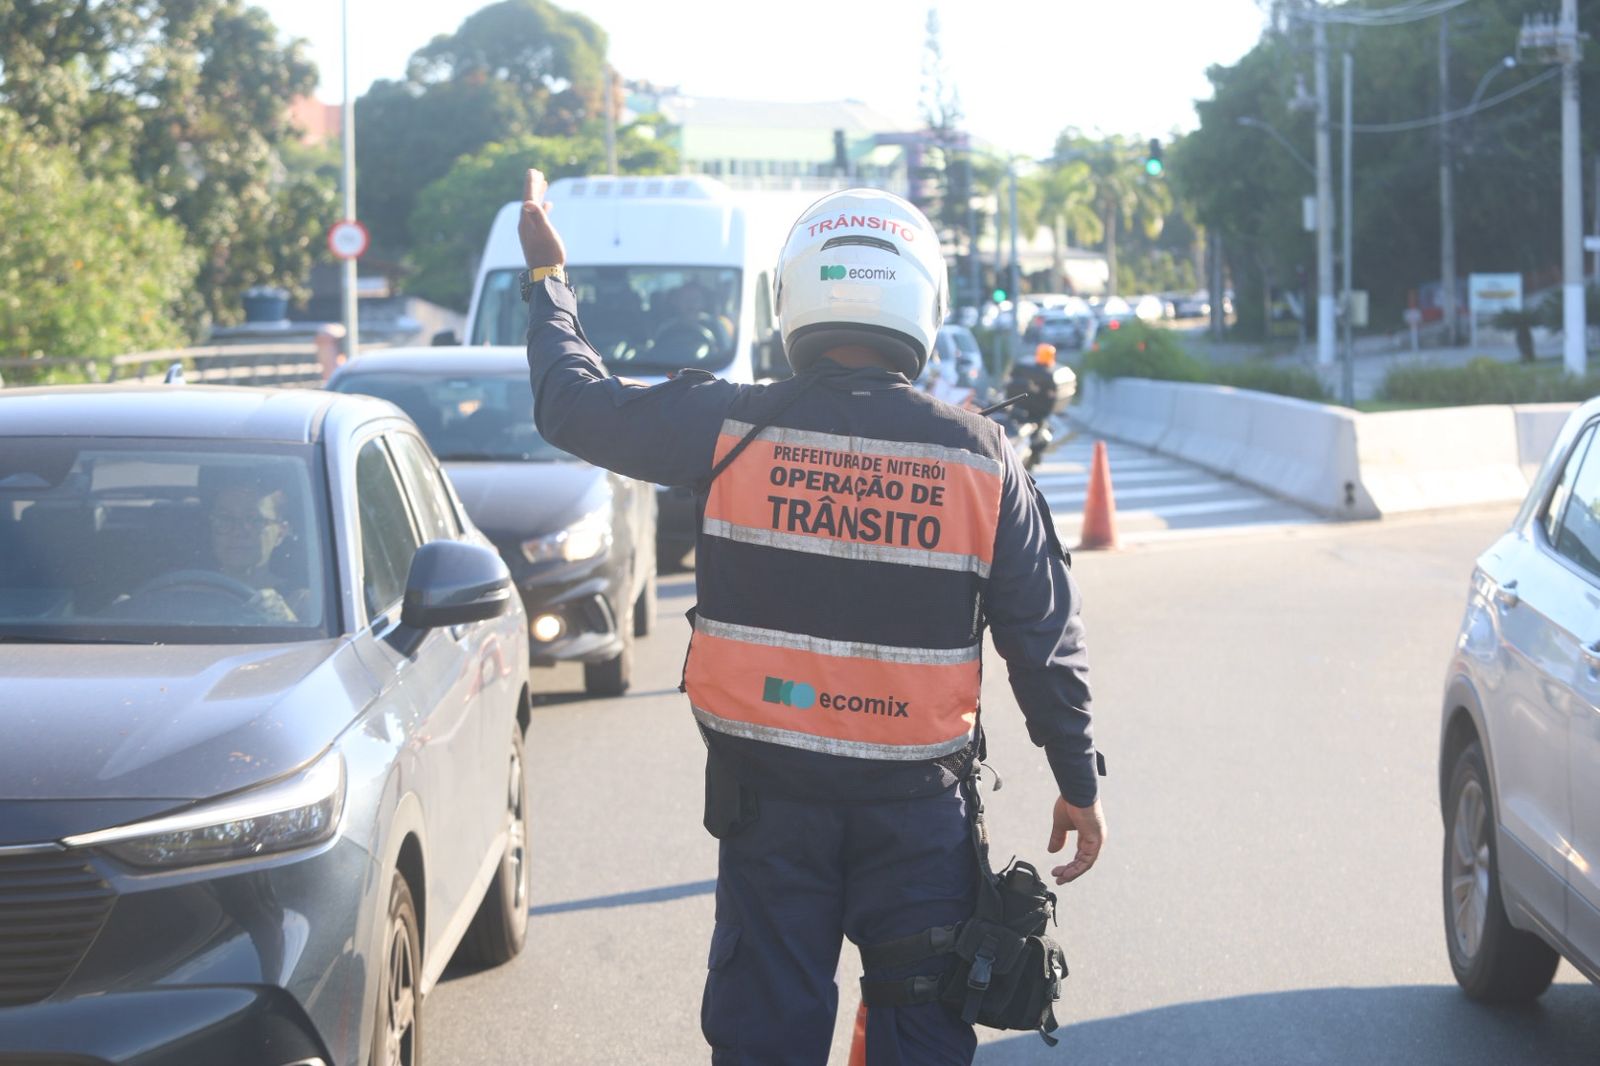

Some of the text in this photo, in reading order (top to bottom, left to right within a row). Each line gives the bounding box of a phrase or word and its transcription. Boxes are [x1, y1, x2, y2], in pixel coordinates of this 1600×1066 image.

[848, 267, 896, 280] ecomix
[774, 445, 946, 481] PREFEITURA DE NITERÓI
[769, 466, 945, 507] OPERAÇÃO DE
[767, 495, 941, 549] TRÂNSITO
[819, 692, 909, 718] ecomix
